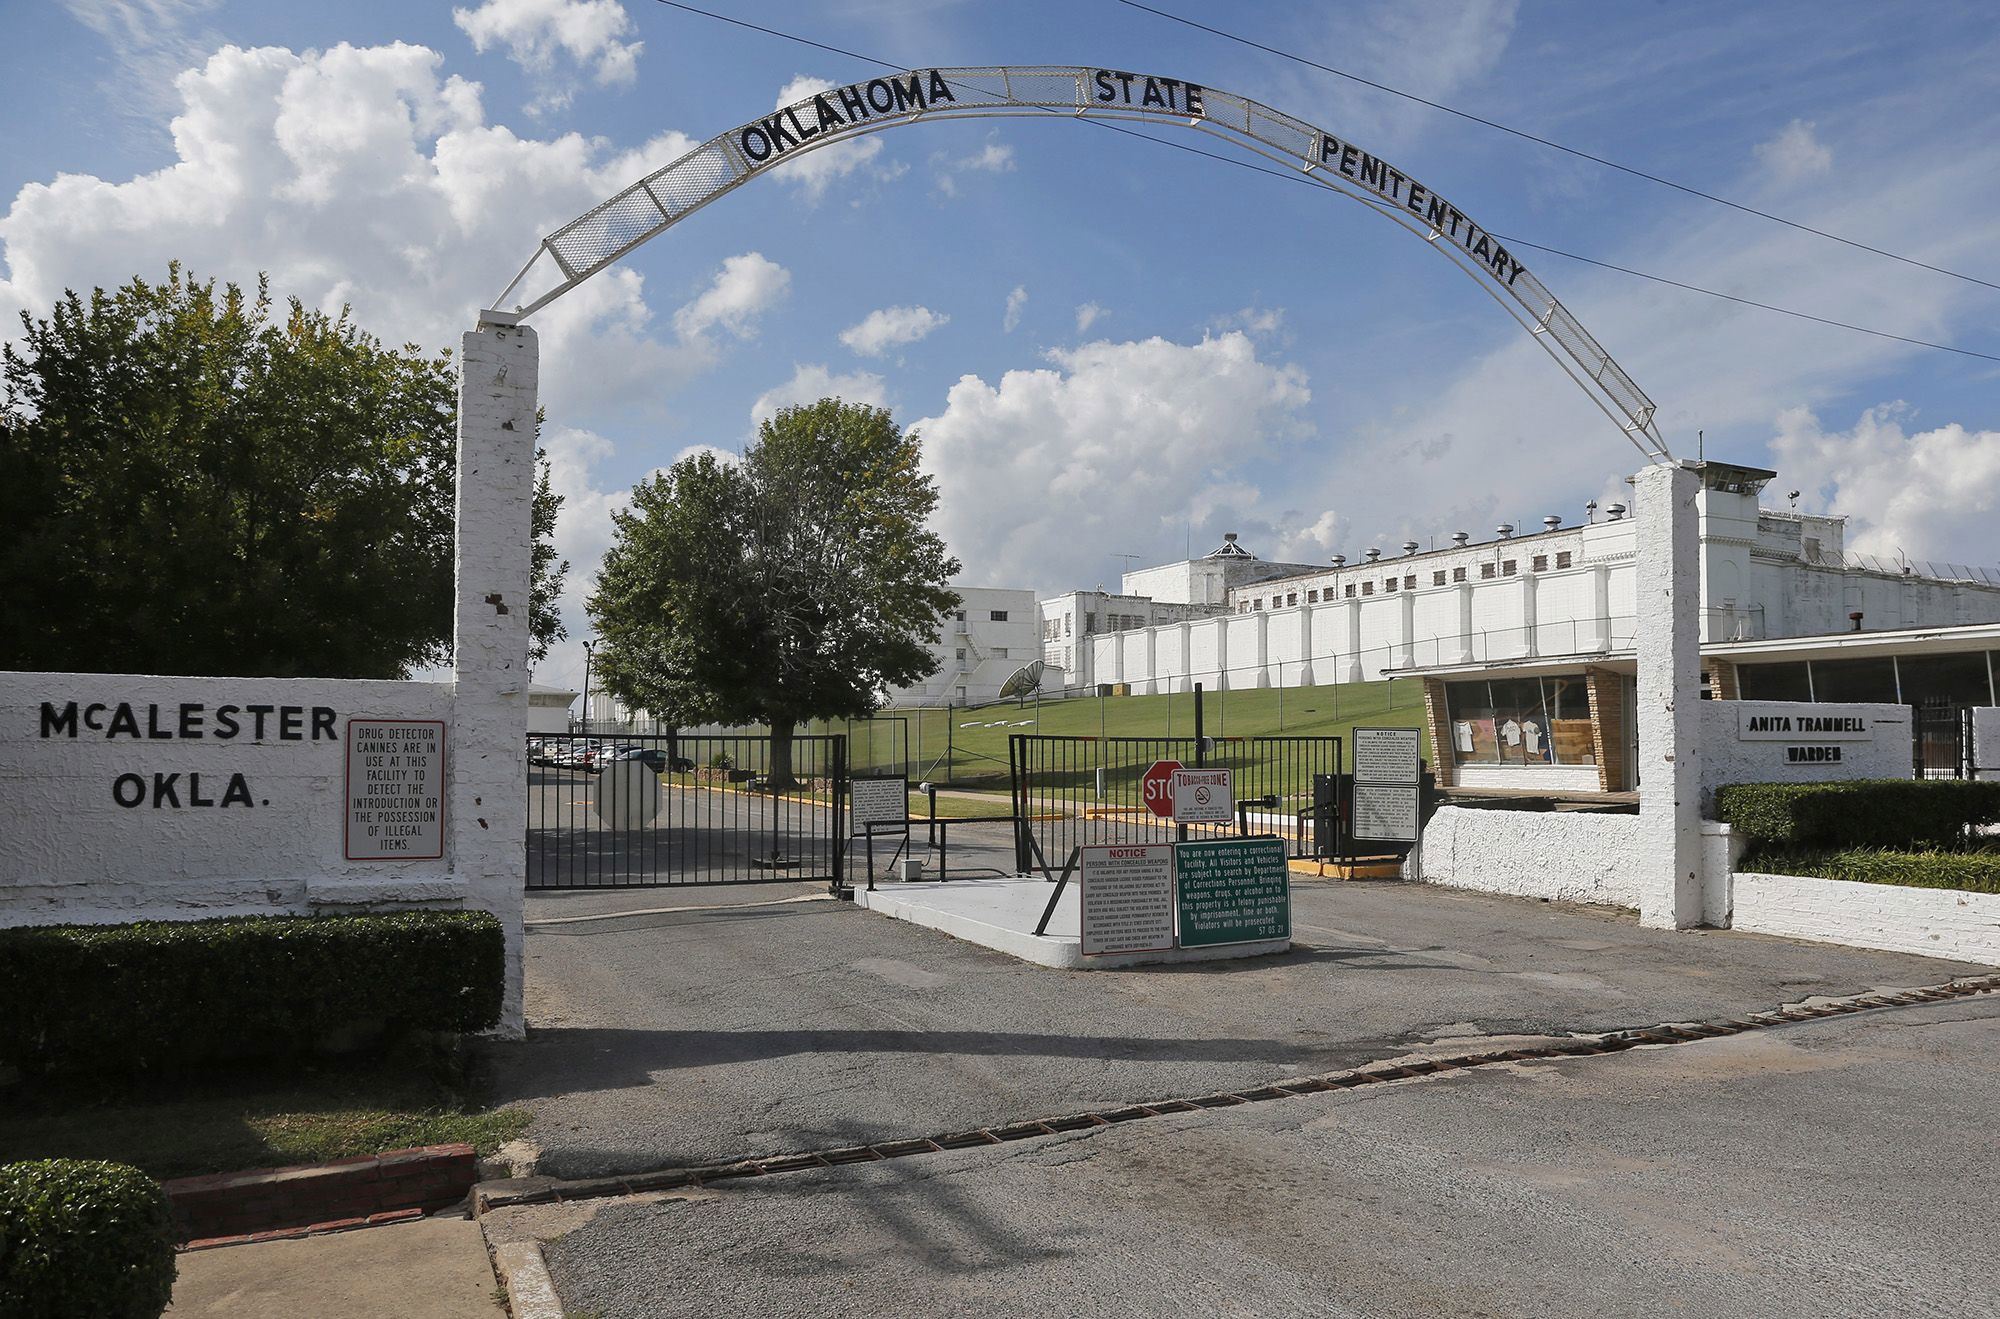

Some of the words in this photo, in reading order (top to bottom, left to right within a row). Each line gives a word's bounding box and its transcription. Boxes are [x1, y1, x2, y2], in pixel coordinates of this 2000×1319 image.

[742, 70, 955, 161] OKLAHOMA
[1096, 70, 1206, 115] STATE
[1321, 135, 1525, 286] PENITENTIARY
[1749, 717, 1791, 732] ANITA
[1796, 717, 1865, 732] TRAMMELL
[359, 728, 383, 739] DRUG
[389, 729, 434, 739] DETECTOR
[357, 742, 397, 753] CANINES
[403, 743, 421, 753] ARE
[427, 743, 436, 753] IN
[1787, 747, 1840, 761] WARDEN
[366, 756, 383, 767] USE
[390, 756, 400, 767] AT
[407, 756, 427, 767] THIS
[367, 770, 407, 780] FACILITY
[414, 770, 424, 780] TO
[1210, 773, 1227, 786] ZONE
[112, 772, 270, 808] OKLA.
[368, 784, 401, 794] DETECT
[407, 784, 424, 794] THE
[353, 798, 420, 808] INTRODUCTION
[426, 798, 438, 808] OR
[355, 812, 372, 822] THE
[378, 812, 435, 822] POSSESSION
[368, 826, 379, 836] OF
[385, 826, 422, 836] ILLEGAL
[380, 839, 410, 850] ITEMS.
[1109, 848, 1146, 858] NOTICE
[1218, 848, 1241, 858] entering
[1250, 845, 1282, 854] correctional
[1210, 859, 1218, 867] All
[1220, 857, 1241, 866] Visitors
[1244, 857, 1254, 865] and
[1257, 855, 1279, 864] Vehicles
[1191, 869, 1212, 880] subject
[1215, 869, 1221, 877] to
[1224, 868, 1242, 876] search
[1245, 867, 1251, 877] by
[1253, 864, 1285, 875] Department
[1184, 881, 1190, 889] of
[1193, 879, 1226, 889] Corrections
[1259, 875, 1281, 886] Bringing
[1244, 886, 1264, 896] alcohol
[1275, 886, 1281, 894] to
[1182, 902, 1193, 910] this
[1196, 900, 1221, 911] property
[1223, 900, 1229, 908] is
[1238, 897, 1255, 907] felony
[1257, 895, 1286, 906] punishable
[1190, 912, 1198, 921] by
[1243, 908, 1254, 916] fine
[1194, 921, 1220, 930] Violators
[1223, 919, 1233, 928] will
[1235, 919, 1242, 927] be
[1258, 926, 1265, 935] 57
[1277, 925, 1284, 933] 21
